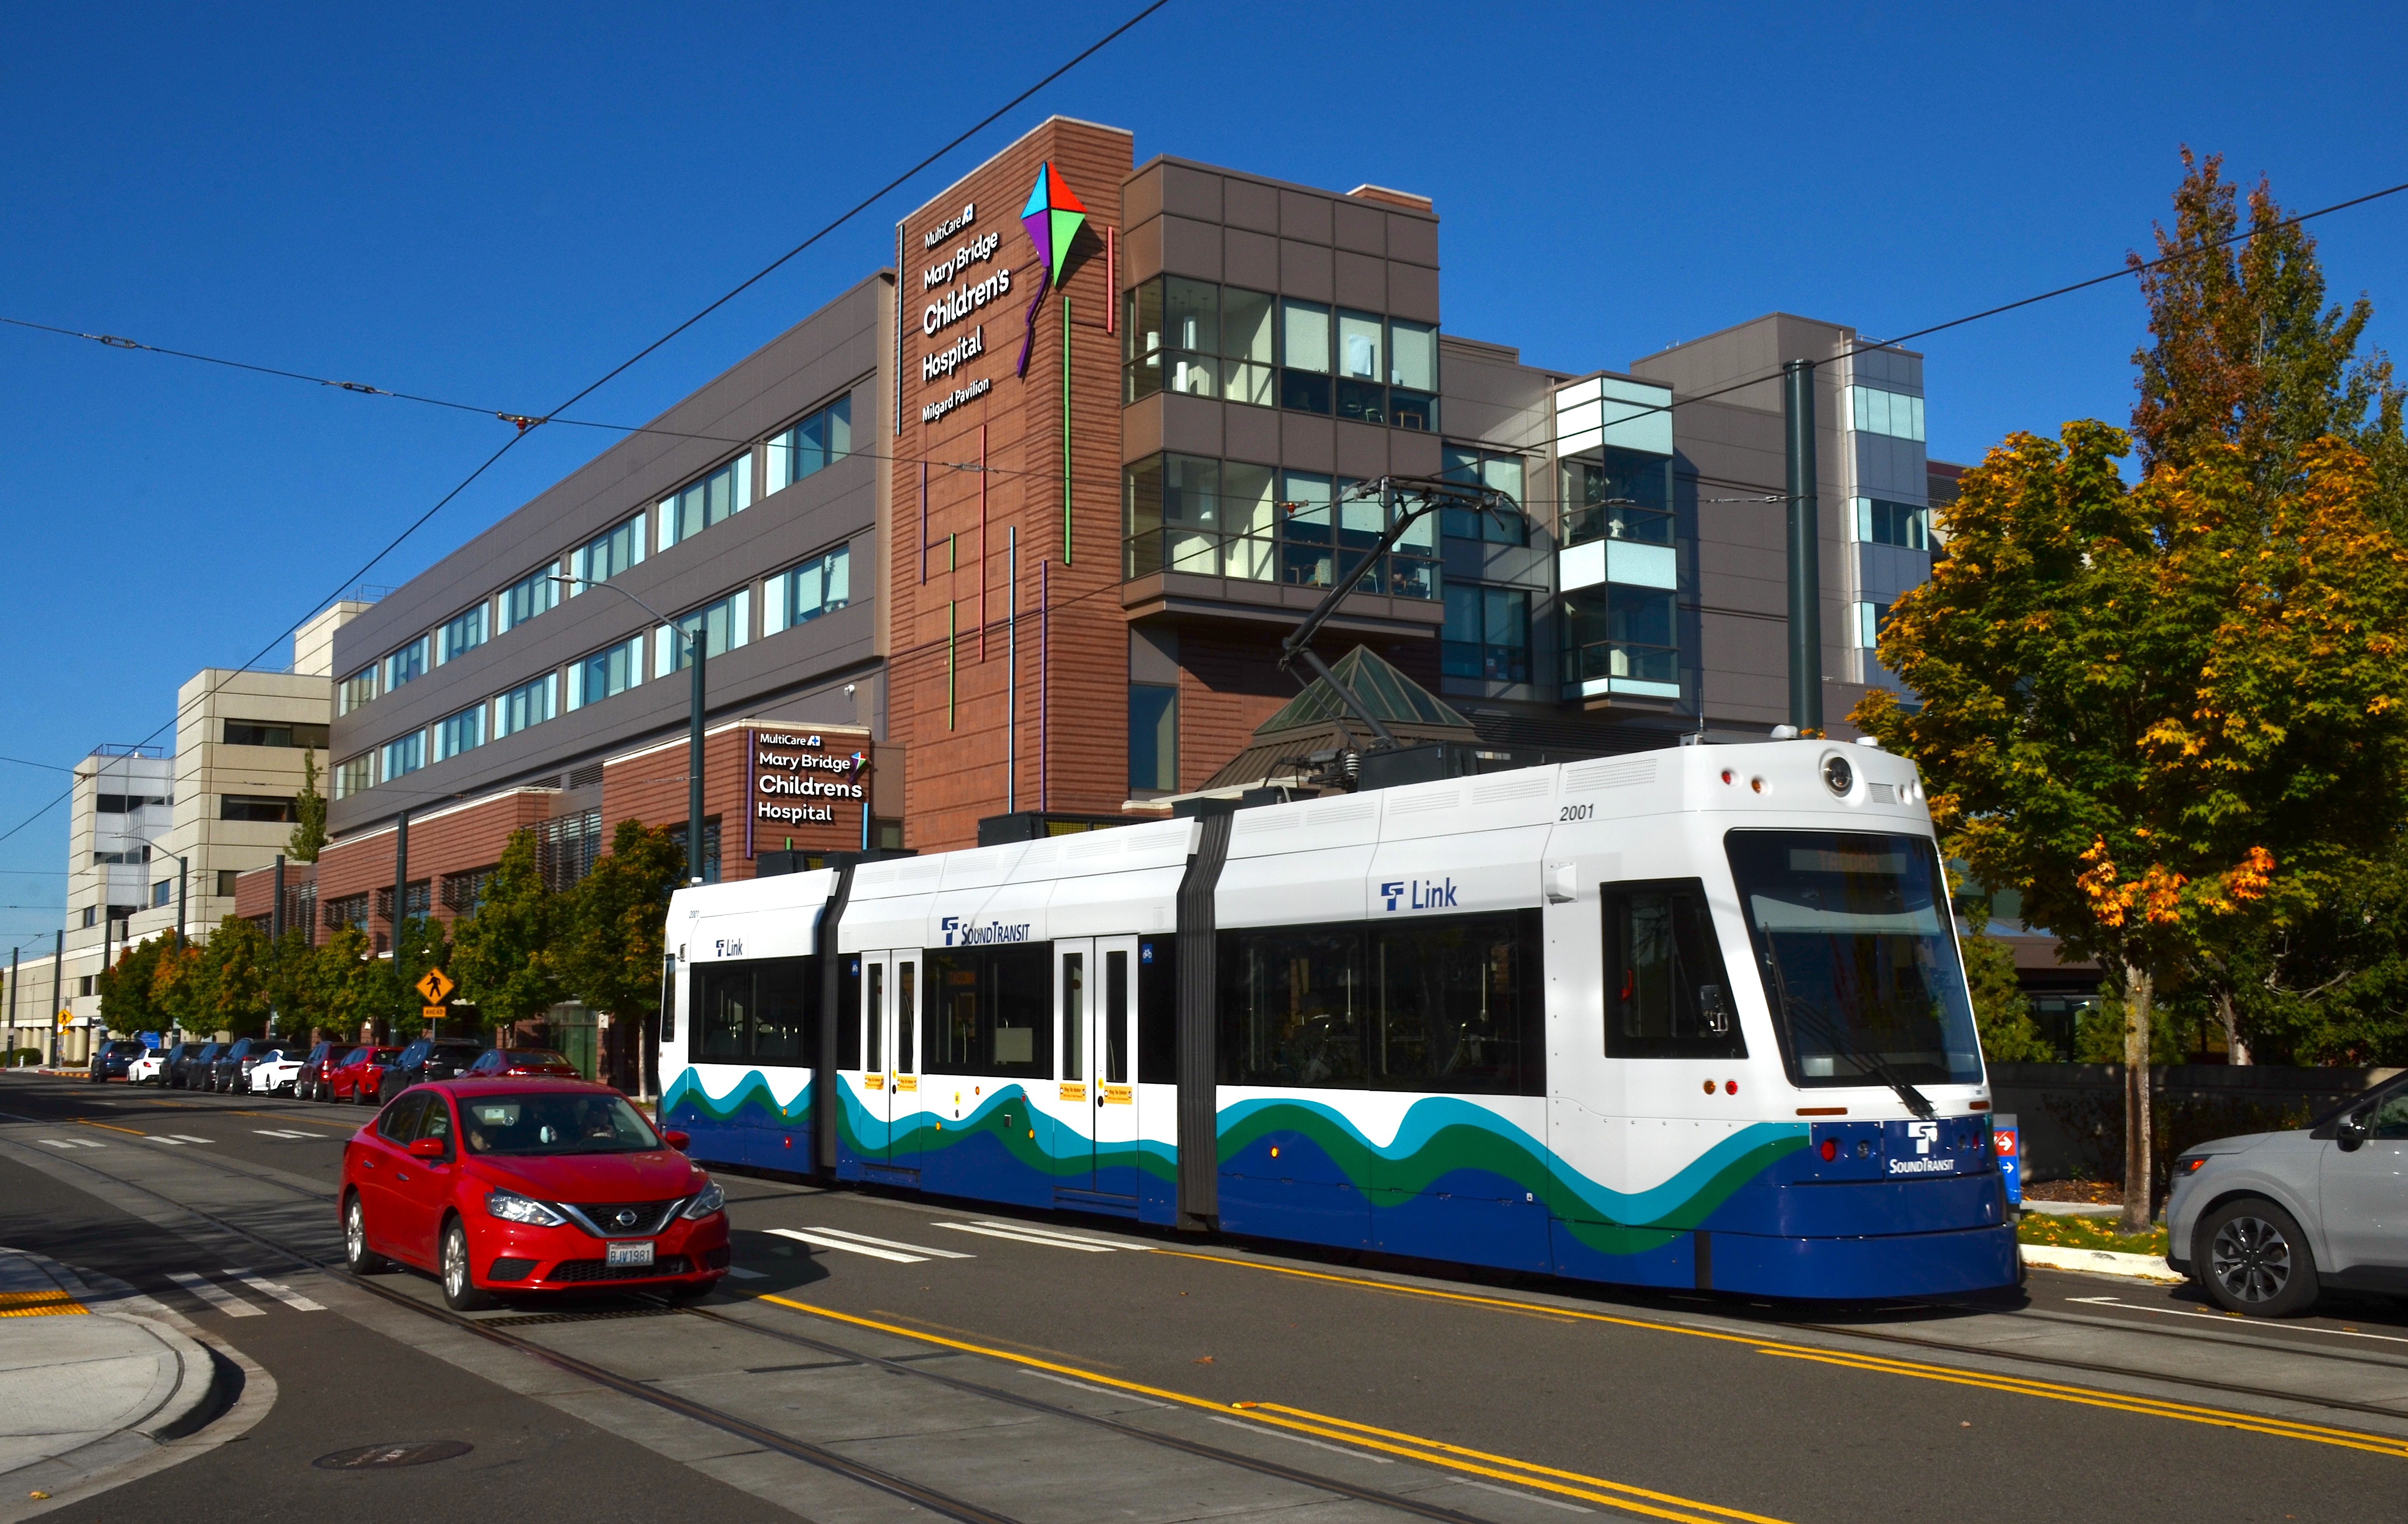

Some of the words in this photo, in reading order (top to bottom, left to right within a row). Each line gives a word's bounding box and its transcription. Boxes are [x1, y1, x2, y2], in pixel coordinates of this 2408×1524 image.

[925, 216, 961, 249] MultiCare
[924, 259, 955, 289] Mary
[956, 231, 998, 270] Bridge
[923, 268, 1009, 335] Children's
[922, 325, 982, 381] Hospital
[922, 392, 954, 422] Milgard
[954, 377, 989, 406] Pavilion
[760, 733, 806, 746] MultiCare
[759, 752, 799, 770] Mary
[802, 754, 851, 773] Bridge
[758, 802, 832, 823] Hospital
[1560, 803, 1595, 821] 2001
[1411, 877, 1457, 910] Link
[726, 938, 743, 957] Link
[610, 1250, 650, 1263] BJV1981
